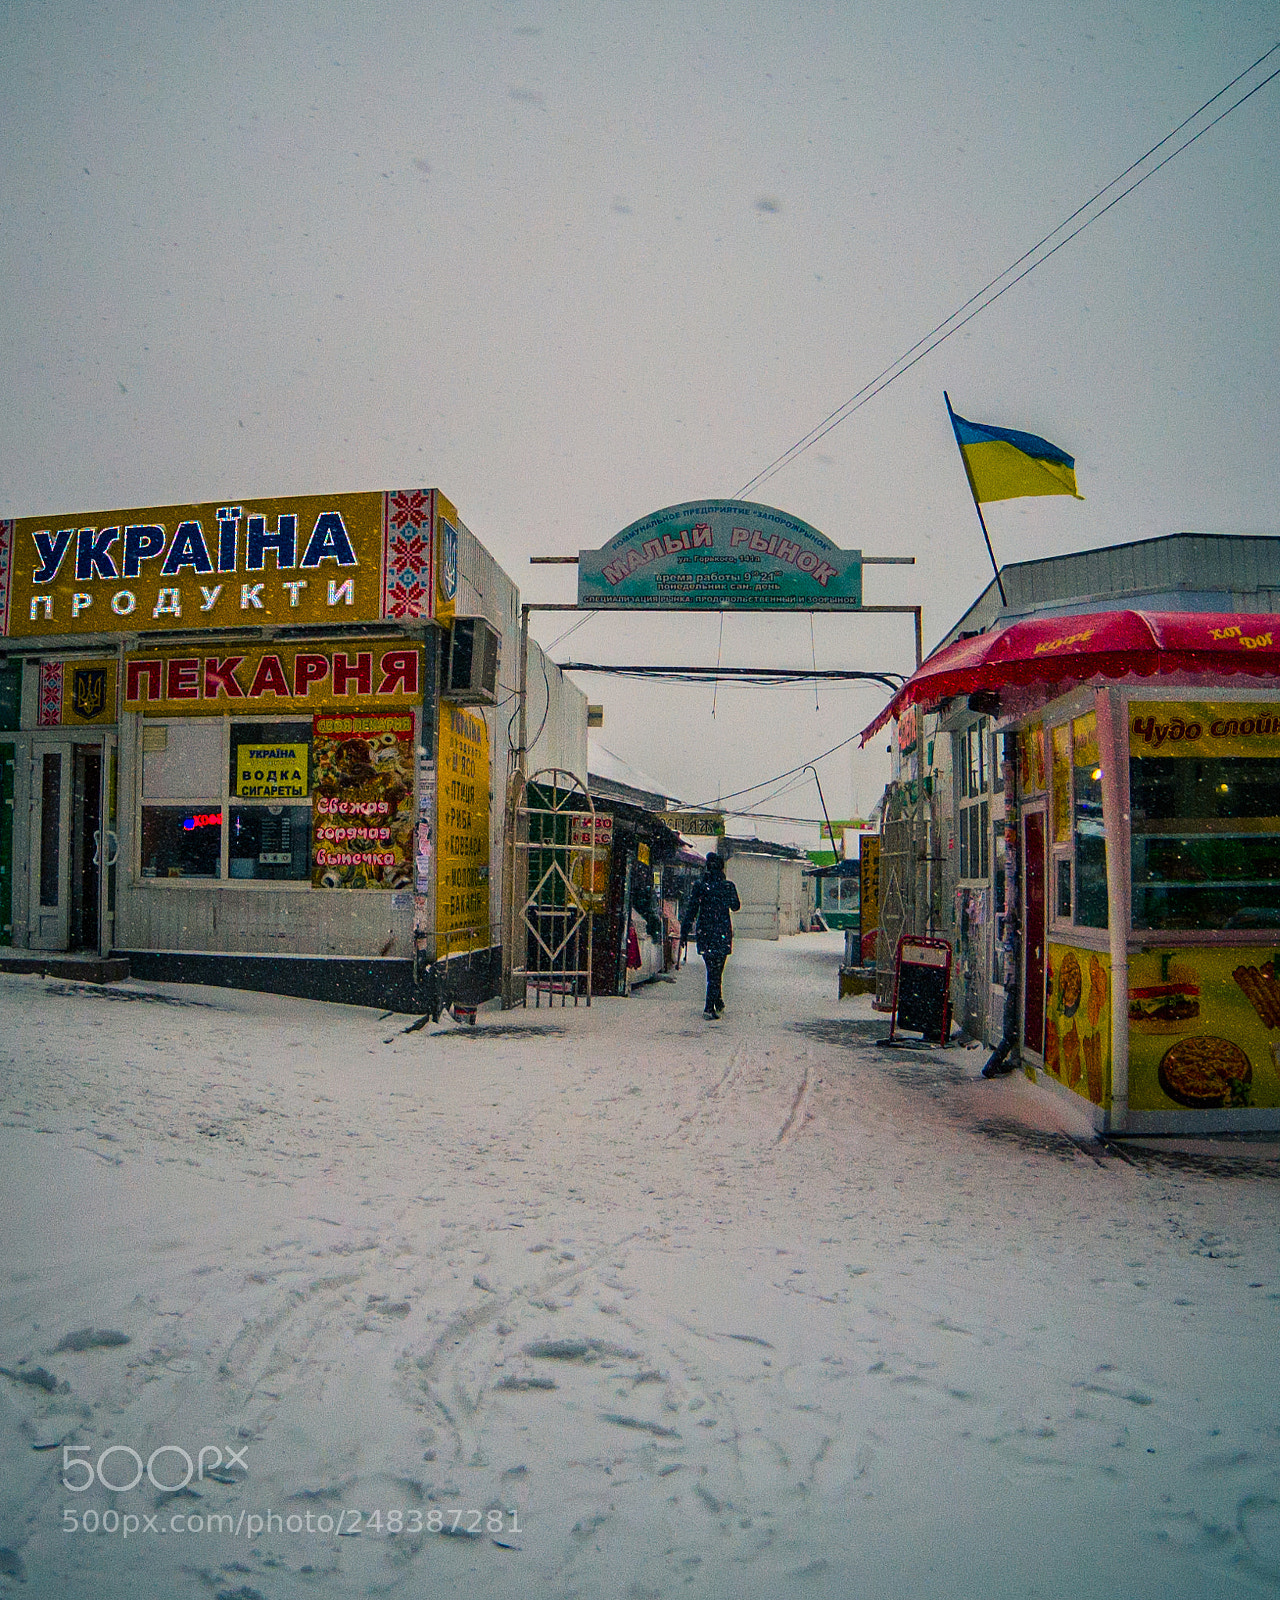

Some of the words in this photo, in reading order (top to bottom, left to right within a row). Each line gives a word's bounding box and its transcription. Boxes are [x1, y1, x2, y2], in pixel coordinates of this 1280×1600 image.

[612, 511, 681, 551] КОММУНАЛЬНОЕ
[682, 505, 750, 517] ПРЕДПРИЯТИЕ
[31, 505, 359, 584] УКРАЇНА
[601, 522, 713, 586] МАЛЫЙ
[730, 527, 838, 588] РЫНОК
[657, 583, 728, 592] понедельник
[755, 583, 781, 592] день
[695, 572, 741, 585] работы
[29, 579, 355, 621] ПРОДУКТИ
[1033, 628, 1096, 654] КОФЕ
[126, 651, 419, 701] ПЕКАРНЯ
[316, 718, 352, 733] СВОЯ
[353, 716, 412, 732] ПЕКАРНЯ
[1132, 716, 1202, 748] Чудо
[249, 749, 296, 759] УКРАЇНА
[242, 770, 302, 783] ВОДКА
[241, 785, 302, 796] СИГАРЕТЫ
[316, 797, 389, 815] Свежая
[316, 826, 391, 844] горячая
[316, 848, 396, 866] выпечка
